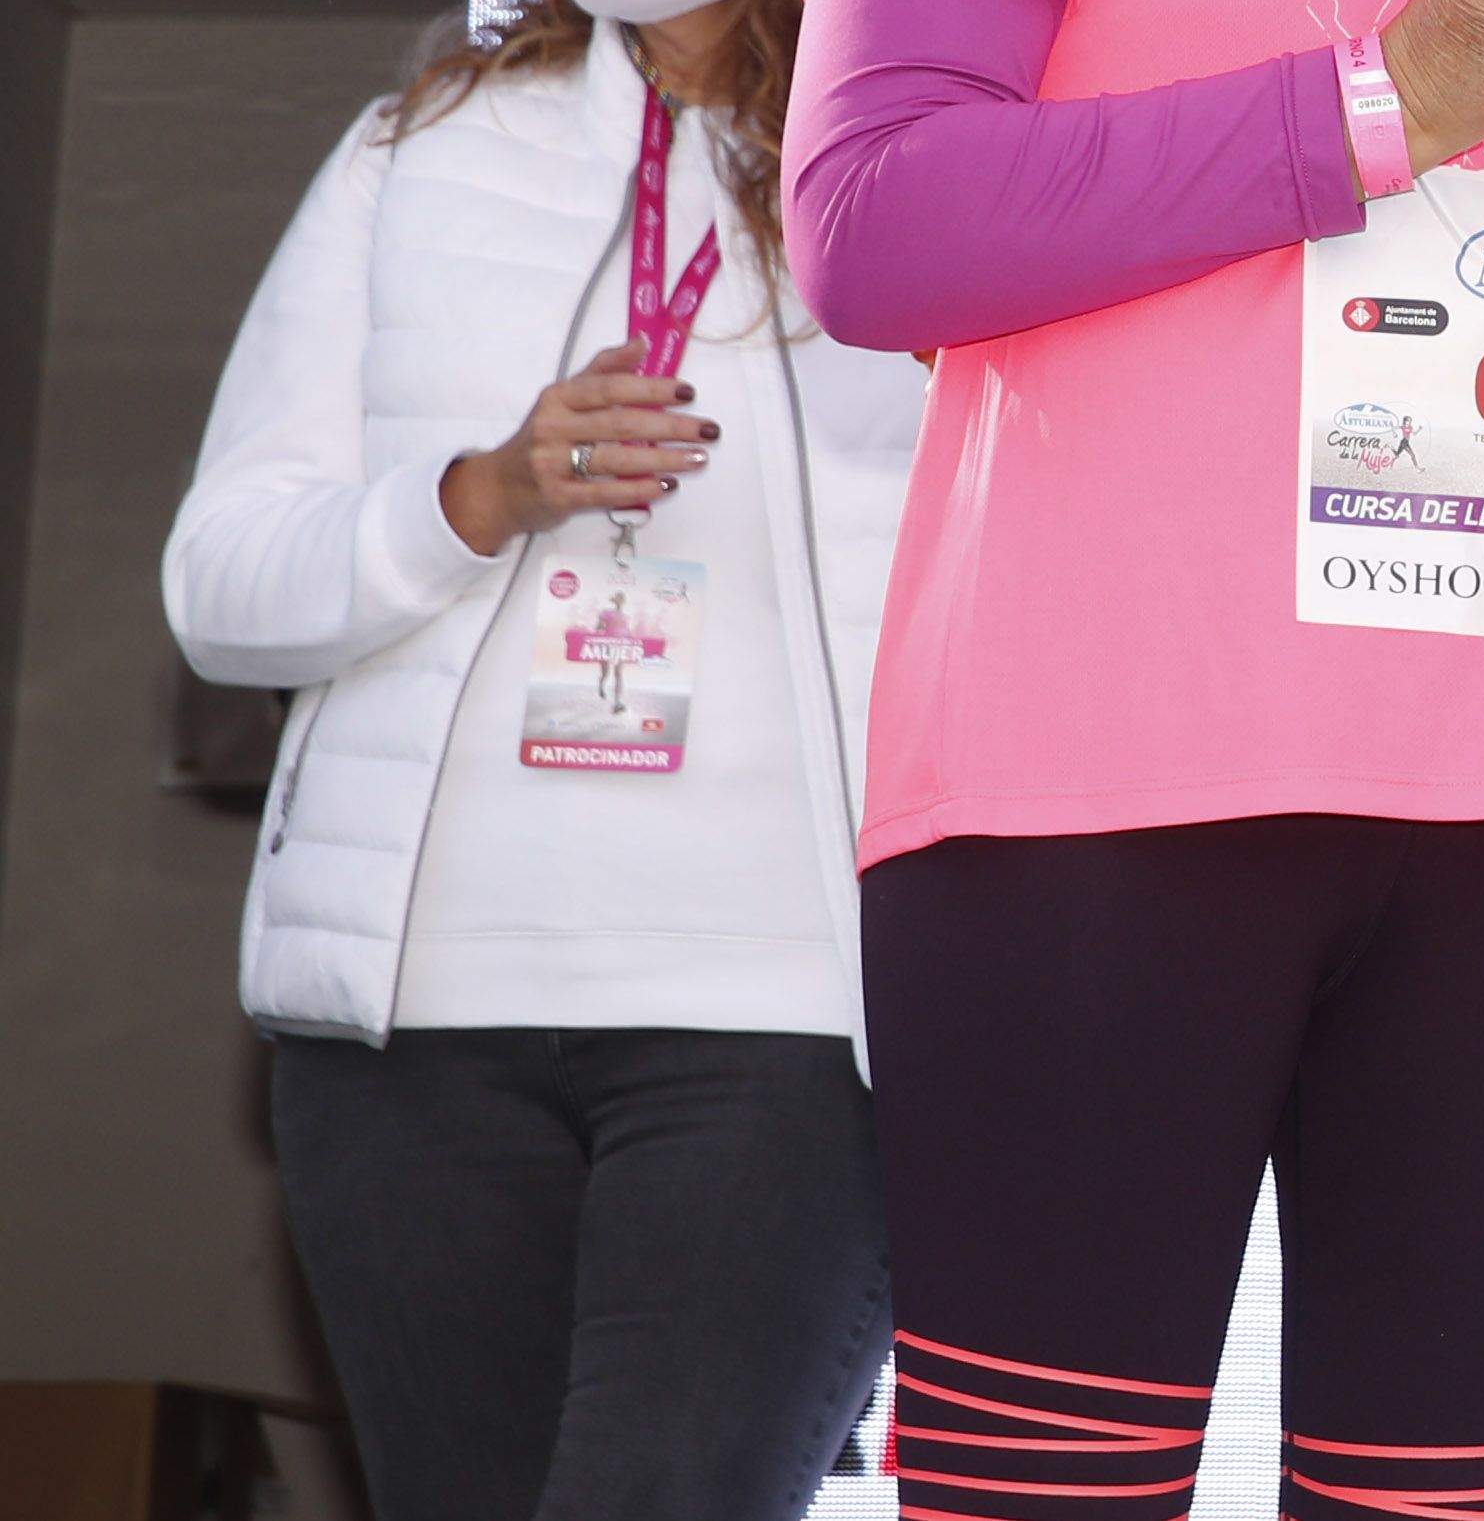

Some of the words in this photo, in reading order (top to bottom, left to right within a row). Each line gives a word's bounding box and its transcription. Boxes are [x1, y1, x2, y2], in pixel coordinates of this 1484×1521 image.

[1384, 314, 1437, 327] Barcelona
[1327, 430, 1381, 449] Carrera
[1357, 448, 1398, 474] Mujer
[1325, 493, 1413, 522] CURSA
[1420, 499, 1460, 525] DE
[1323, 556, 1481, 599] OYSHO
[530, 745, 670, 767] PATROCINADOR
